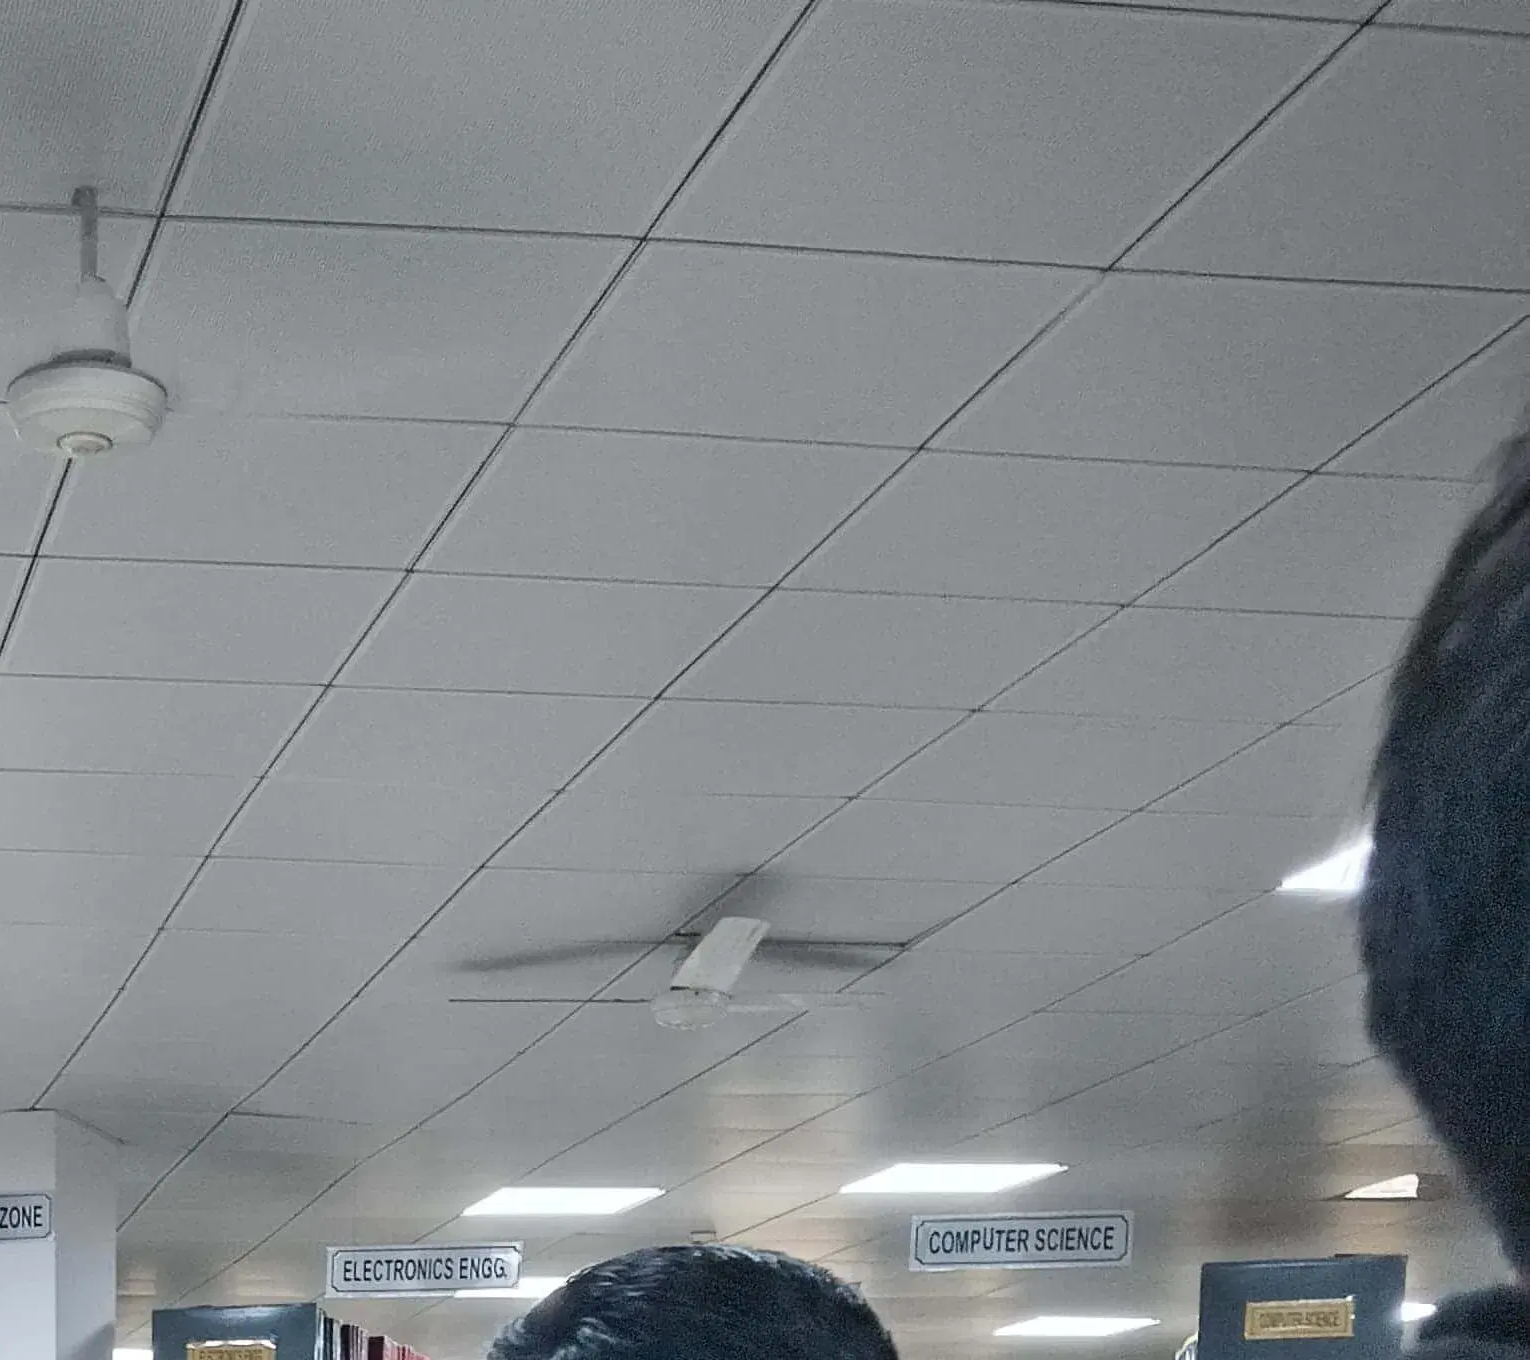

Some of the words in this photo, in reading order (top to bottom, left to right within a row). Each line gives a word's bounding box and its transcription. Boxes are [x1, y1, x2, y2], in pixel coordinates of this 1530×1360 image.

[0, 1205, 43, 1229] ZONE
[929, 1227, 1030, 1254] COMPUTER
[1034, 1226, 1115, 1252] SCIENCE
[343, 1258, 454, 1282] ELECTRONICS
